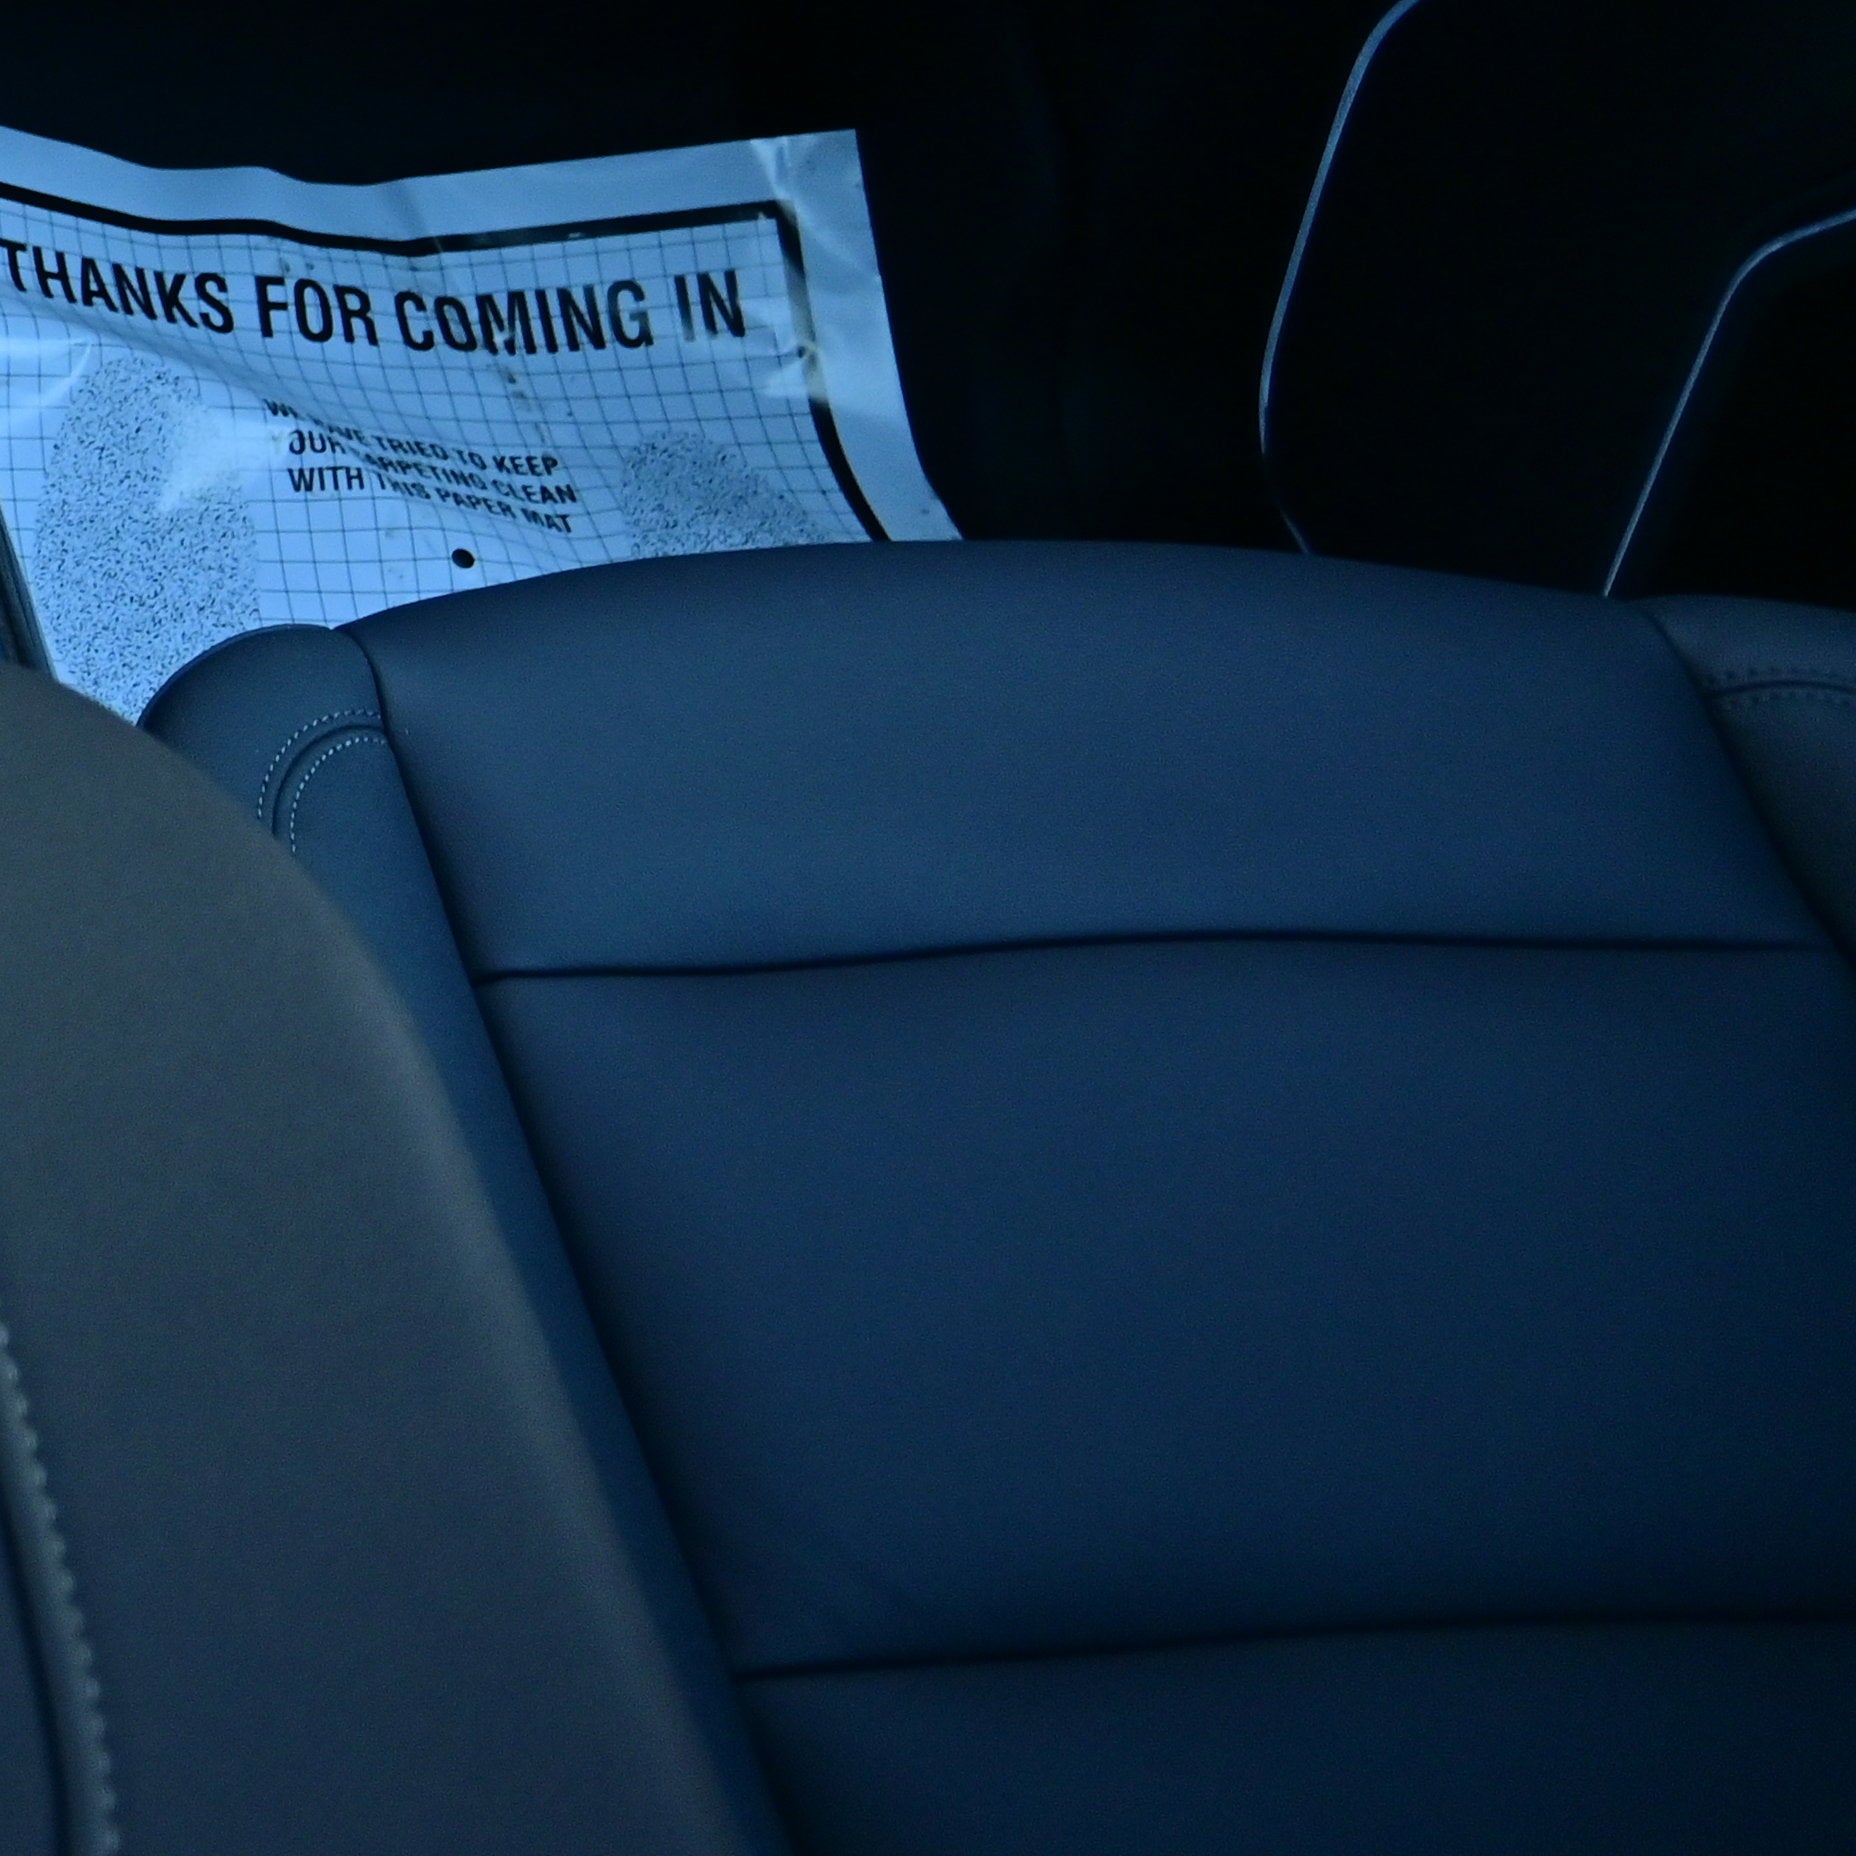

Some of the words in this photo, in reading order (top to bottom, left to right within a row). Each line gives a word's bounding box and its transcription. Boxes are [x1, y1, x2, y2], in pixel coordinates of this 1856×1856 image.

[255, 275, 379, 346] FOR
[394, 279, 655, 356] COMING
[674, 269, 746, 342] IN
[271, 429, 347, 456] OUR
[491, 478, 578, 505] CLEAN
[373, 434, 450, 462] TRIED
[456, 447, 487, 472] TO
[492, 455, 559, 477] KEEP
[288, 465, 365, 493] WITH
[435, 487, 516, 520] PAPER
[521, 507, 572, 534] MAT
